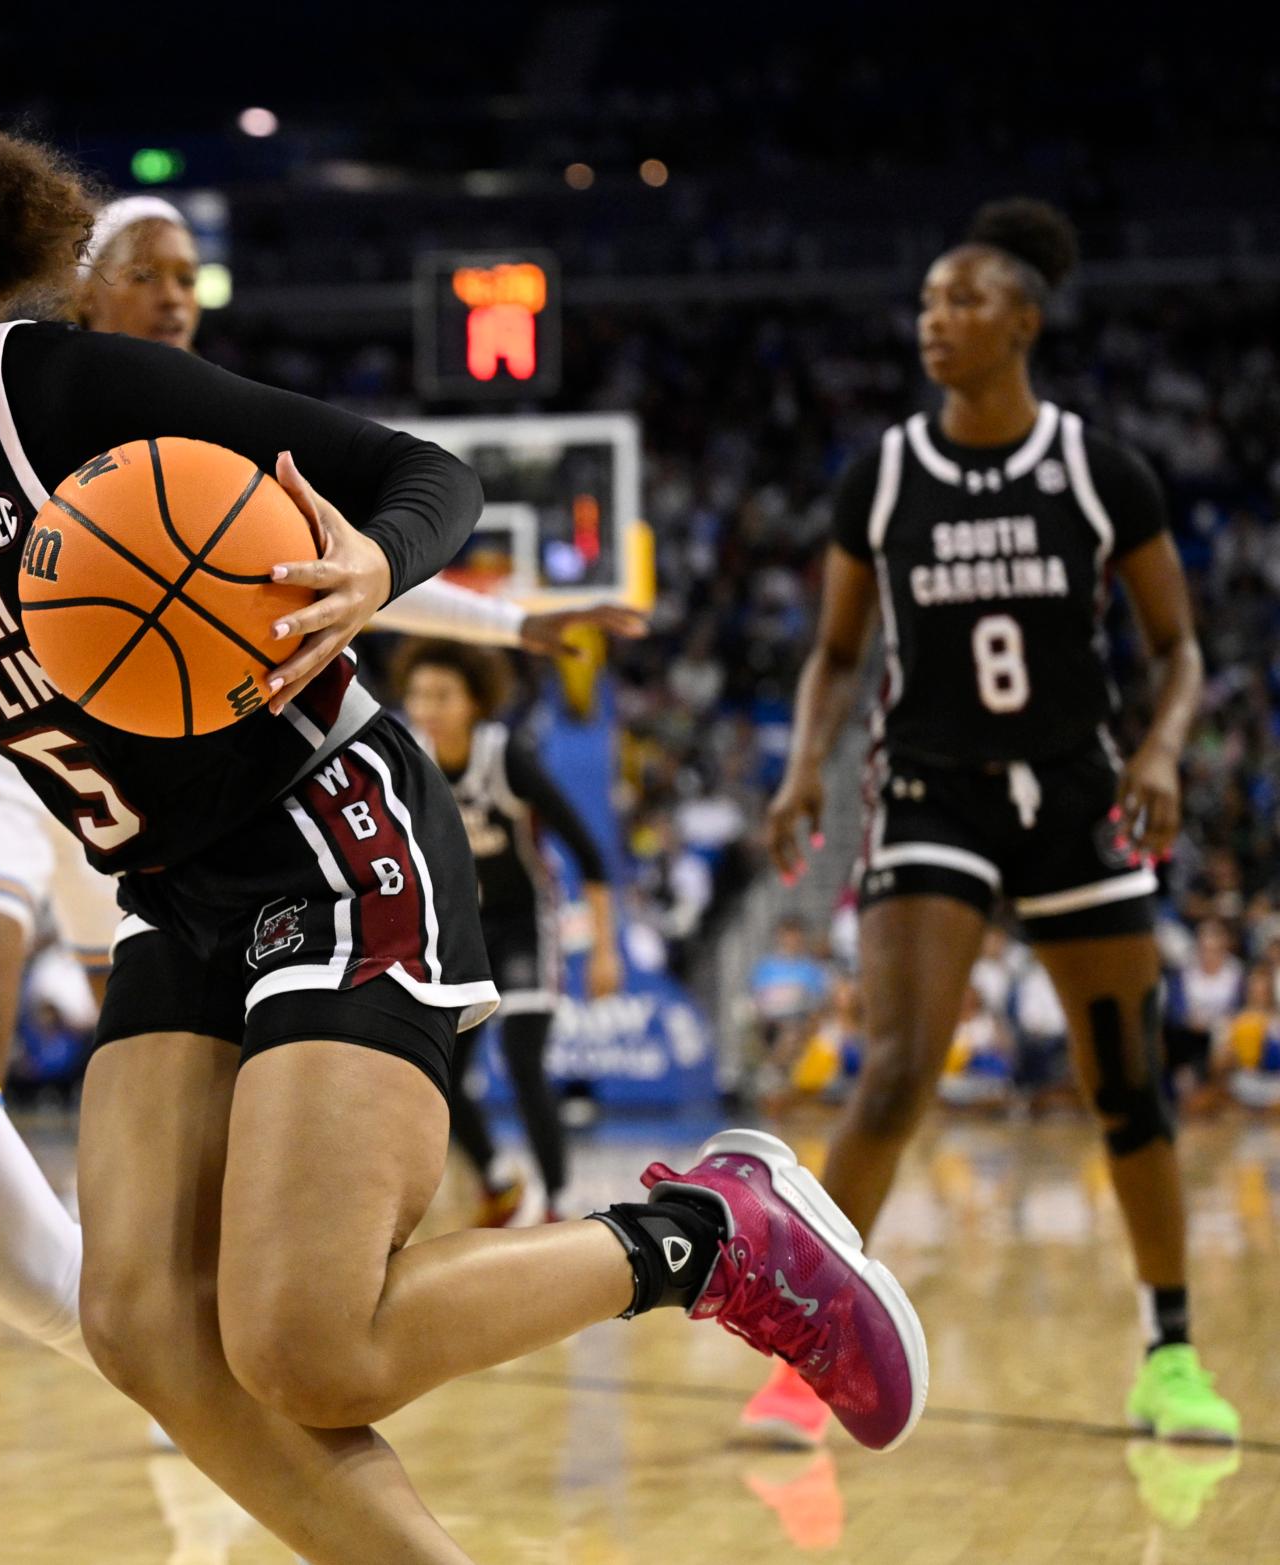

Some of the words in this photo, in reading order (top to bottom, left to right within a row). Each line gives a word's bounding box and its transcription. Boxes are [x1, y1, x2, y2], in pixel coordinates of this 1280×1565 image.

[932, 515, 1039, 562] SOUTH
[910, 555, 1069, 606] CAROLINA
[972, 613, 1030, 714] 8
[5, 728, 142, 852] 5
